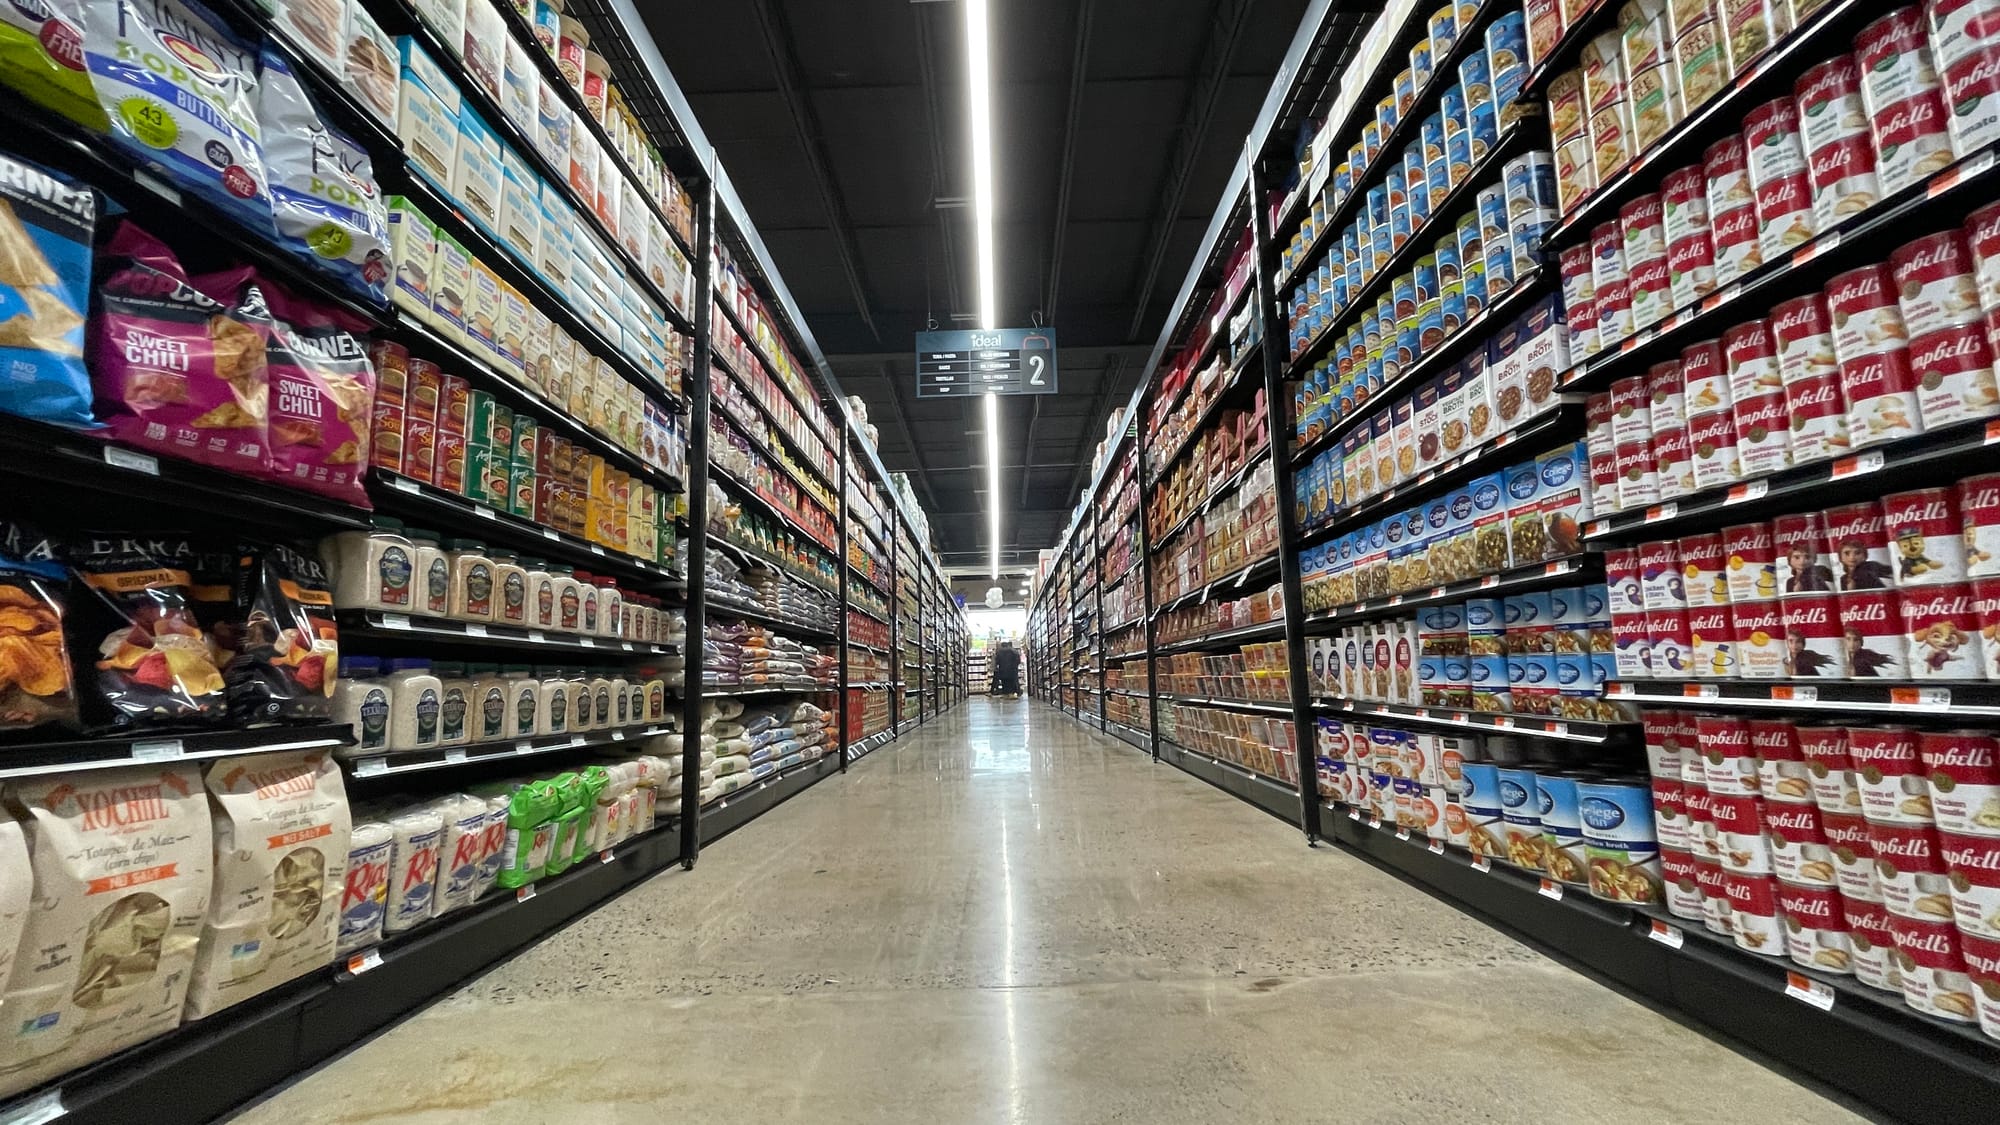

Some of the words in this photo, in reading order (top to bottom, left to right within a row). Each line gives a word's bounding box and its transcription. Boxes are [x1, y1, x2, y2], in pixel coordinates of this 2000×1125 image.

[139, 105, 163, 127] 43
[228, 173, 254, 196] FREE
[126, 331, 189, 354] SWEET
[971, 334, 1002, 348] ideal
[125, 346, 190, 372] CHILI
[1527, 340, 1553, 362] BROTH
[1029, 355, 1046, 386] 2
[1498, 360, 1521, 381] BROTH
[280, 379, 321, 401] SWEET
[279, 394, 322, 418] CHILI
[178, 429, 198, 442] 130
[1542, 462, 1573, 479] College
[1551, 474, 1566, 486] Inn
[1510, 476, 1537, 491] College
[1518, 487, 1532, 498] Inn
[1475, 489, 1499, 504] College
[1452, 501, 1473, 514] College
[92, 537, 194, 556] ERRA
[279, 543, 325, 580] TERR
[116, 572, 174, 588] ORIGINAL
[283, 835, 297, 843] NO
[299, 828, 320, 840] SALT
[109, 874, 128, 888] NO
[131, 869, 159, 883] SALT
